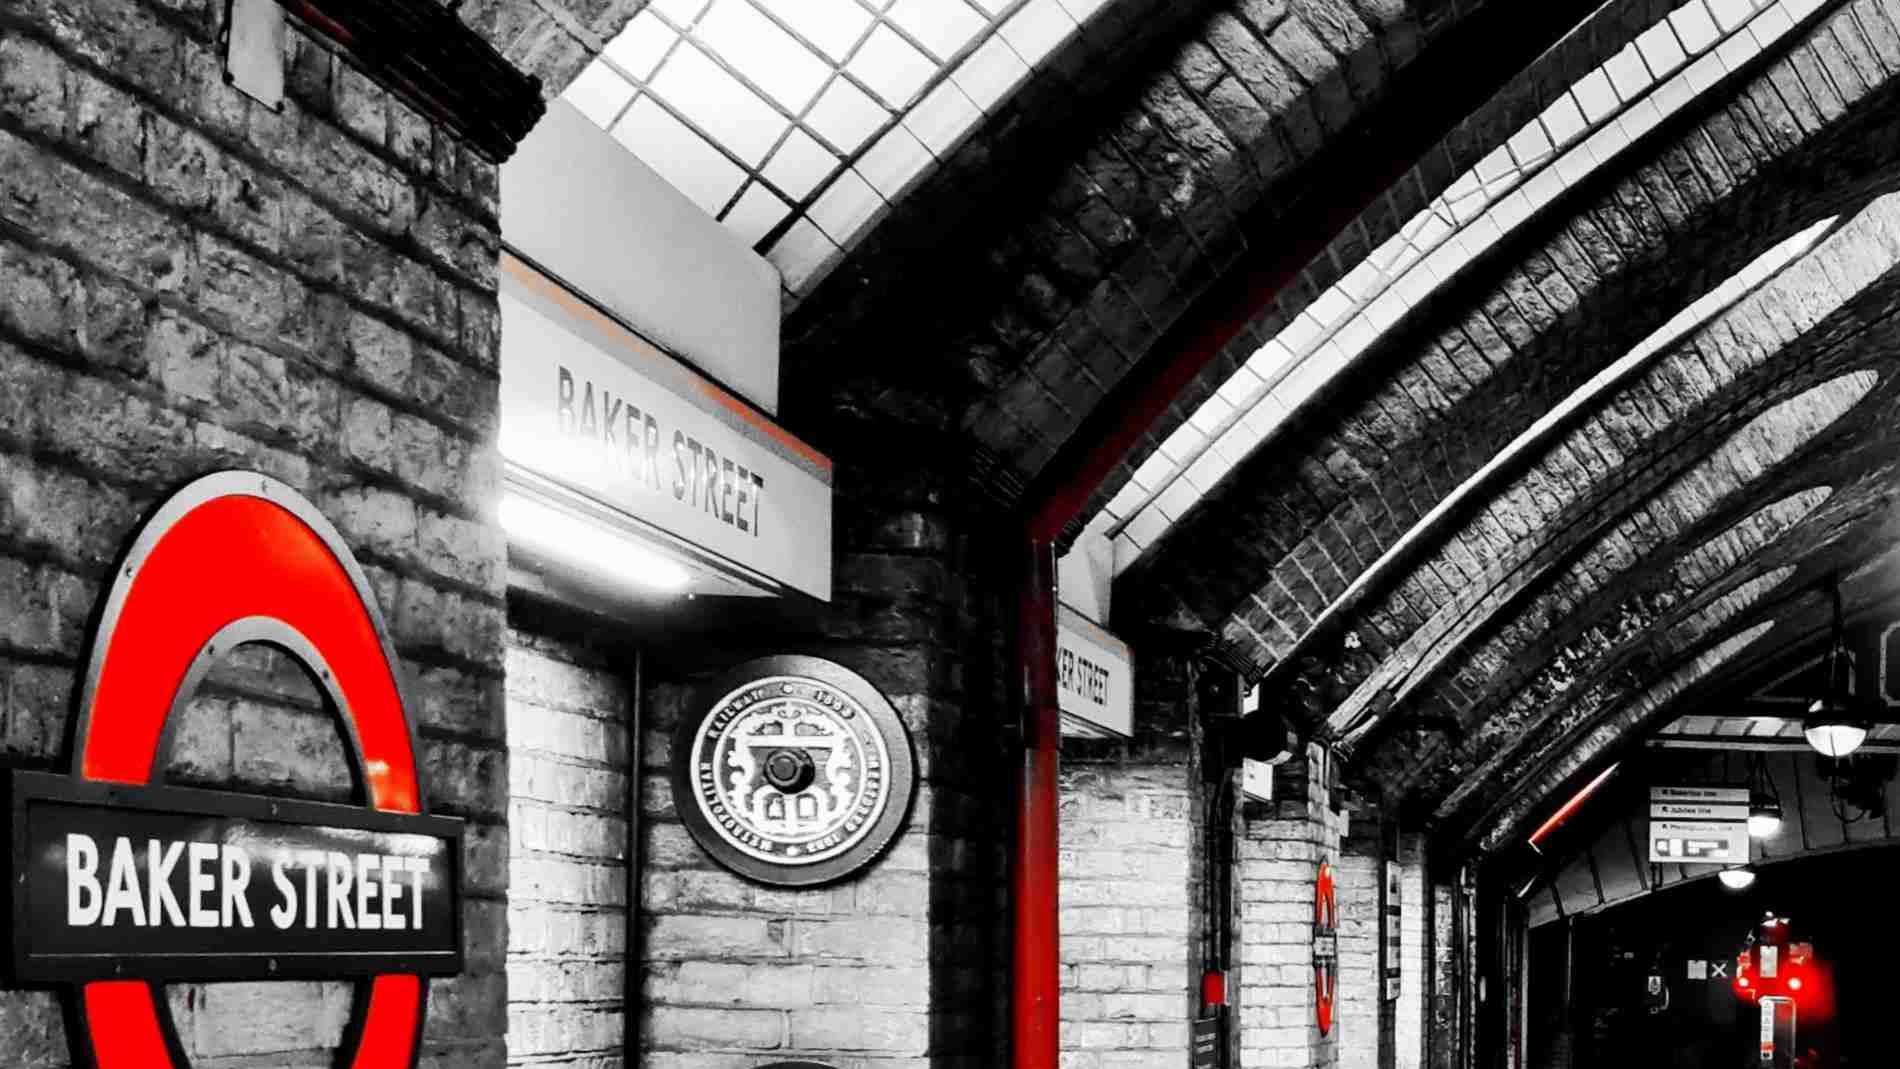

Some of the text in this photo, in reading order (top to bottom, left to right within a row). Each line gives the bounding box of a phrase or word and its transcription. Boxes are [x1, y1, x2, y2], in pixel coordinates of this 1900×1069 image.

[559, 366, 764, 537] BAKER STREET
[1057, 646, 1109, 707] KER STREET
[66, 832, 431, 930] BAKER STREET
